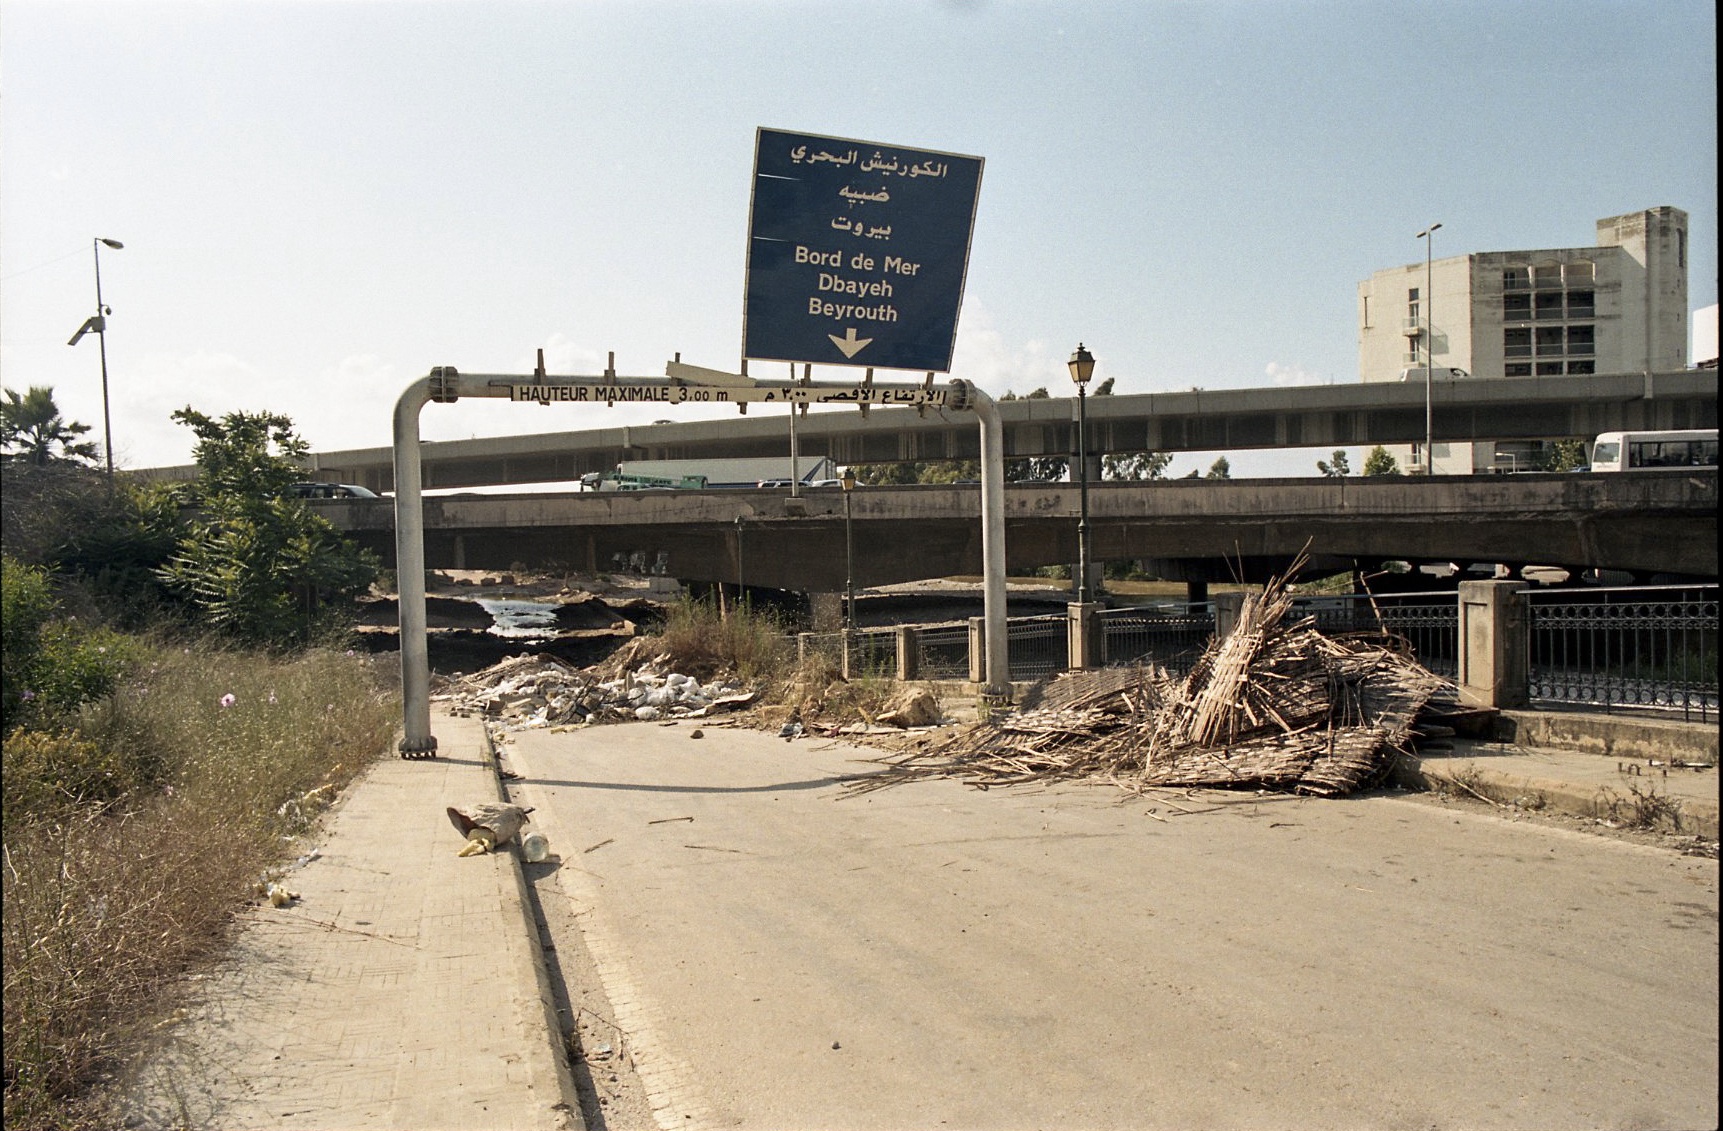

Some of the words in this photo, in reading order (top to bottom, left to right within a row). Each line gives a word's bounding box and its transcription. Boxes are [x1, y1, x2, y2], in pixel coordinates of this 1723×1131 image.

[790, 144, 858, 167] البحري
[860, 151, 948, 178] الكورنيش
[831, 216, 892, 240] بيروت
[795, 246, 842, 267] Bord
[851, 253, 875, 270] de
[884, 256, 921, 276] Mer
[819, 273, 893, 297] Dbayeh
[808, 298, 898, 322] Beyrouth
[519, 386, 588, 401] HAUTEUR
[595, 386, 669, 401] MAXIMALE
[716, 390, 729, 401] m
